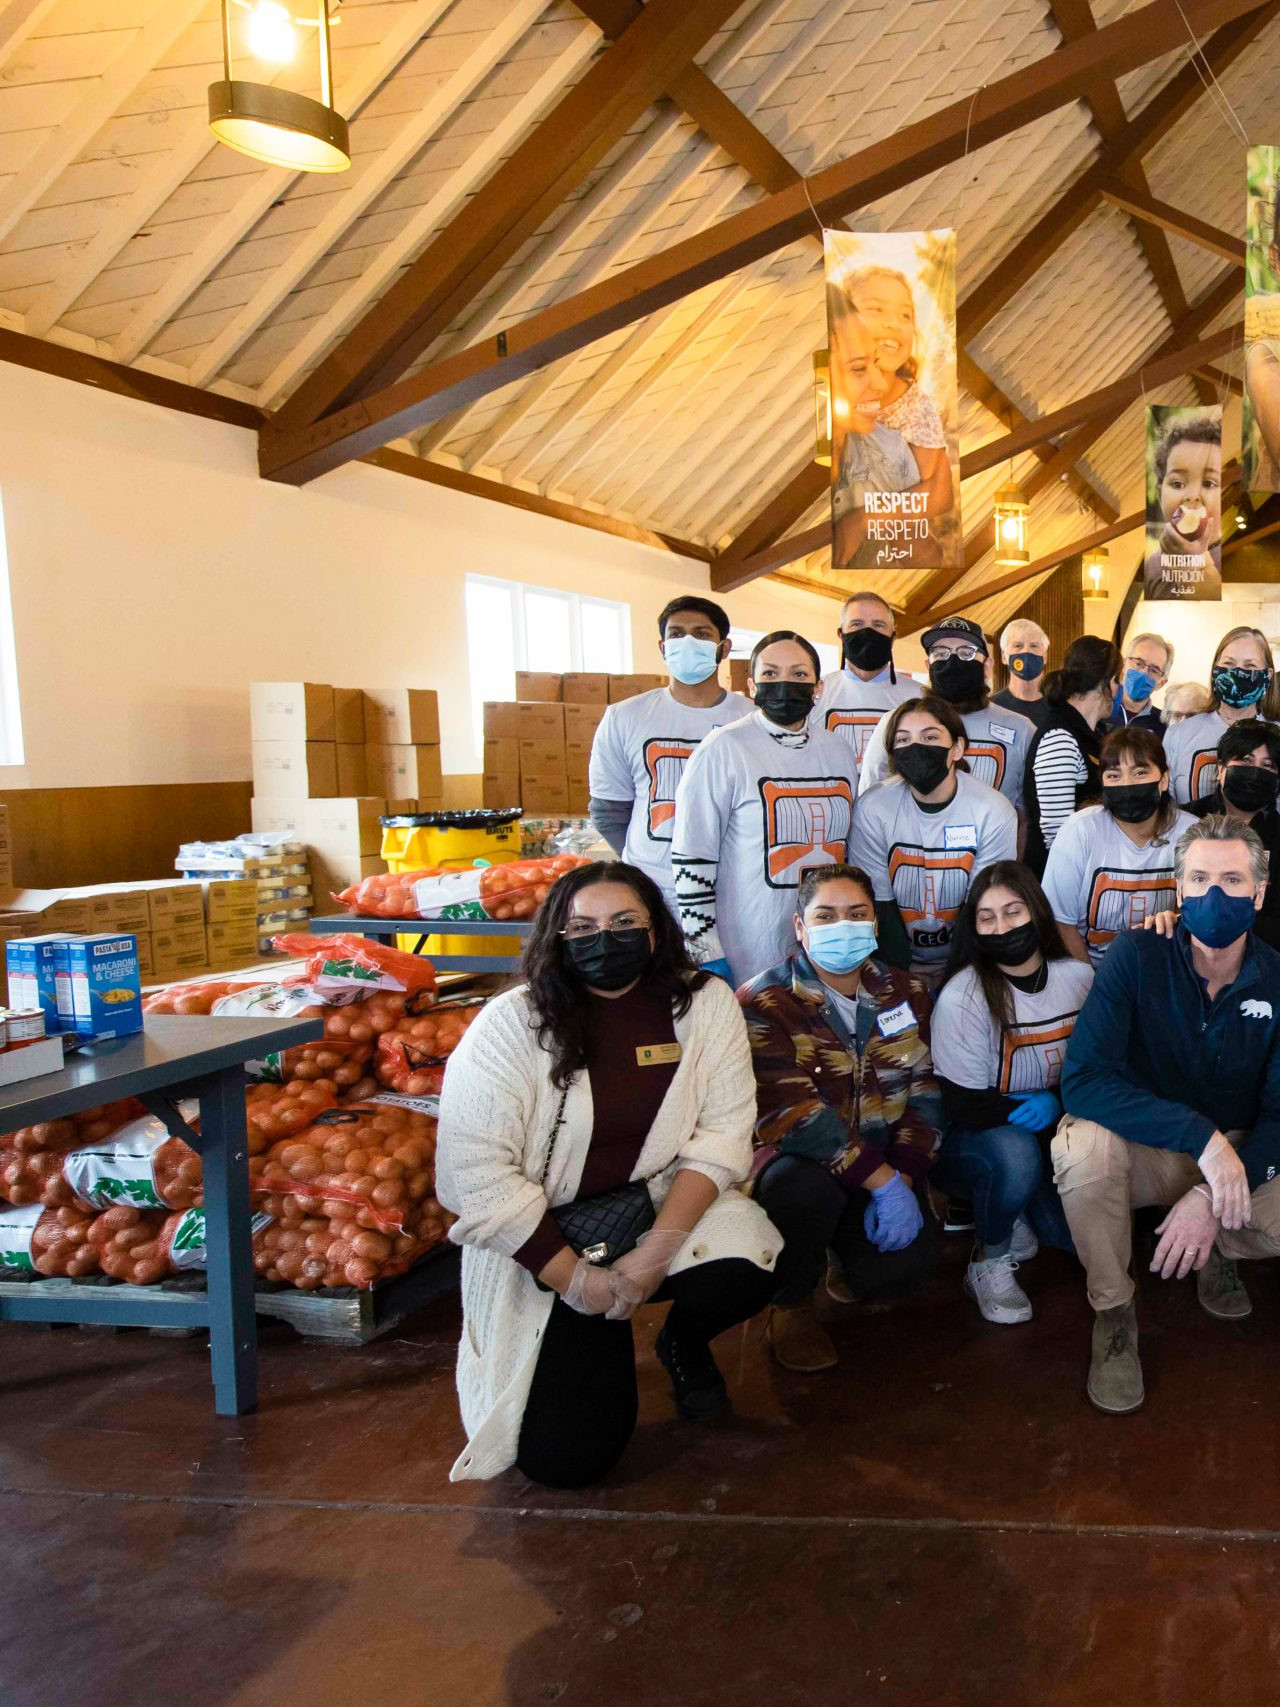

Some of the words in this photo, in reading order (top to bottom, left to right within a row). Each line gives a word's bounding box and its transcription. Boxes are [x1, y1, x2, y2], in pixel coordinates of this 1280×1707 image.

[864, 491, 930, 513] RESPECT
[867, 518, 929, 540] RESPETO
[876, 543, 913, 566] احترام
[1160, 554, 1206, 567] NUTRITION
[918, 930, 945, 946] CEC
[95, 945, 112, 954] PASTA
[93, 958, 136, 972] MACARONI
[96, 973, 103, 981] &
[104, 967, 135, 980] CHEESE
[375, 1096, 432, 1109] OTATOES
